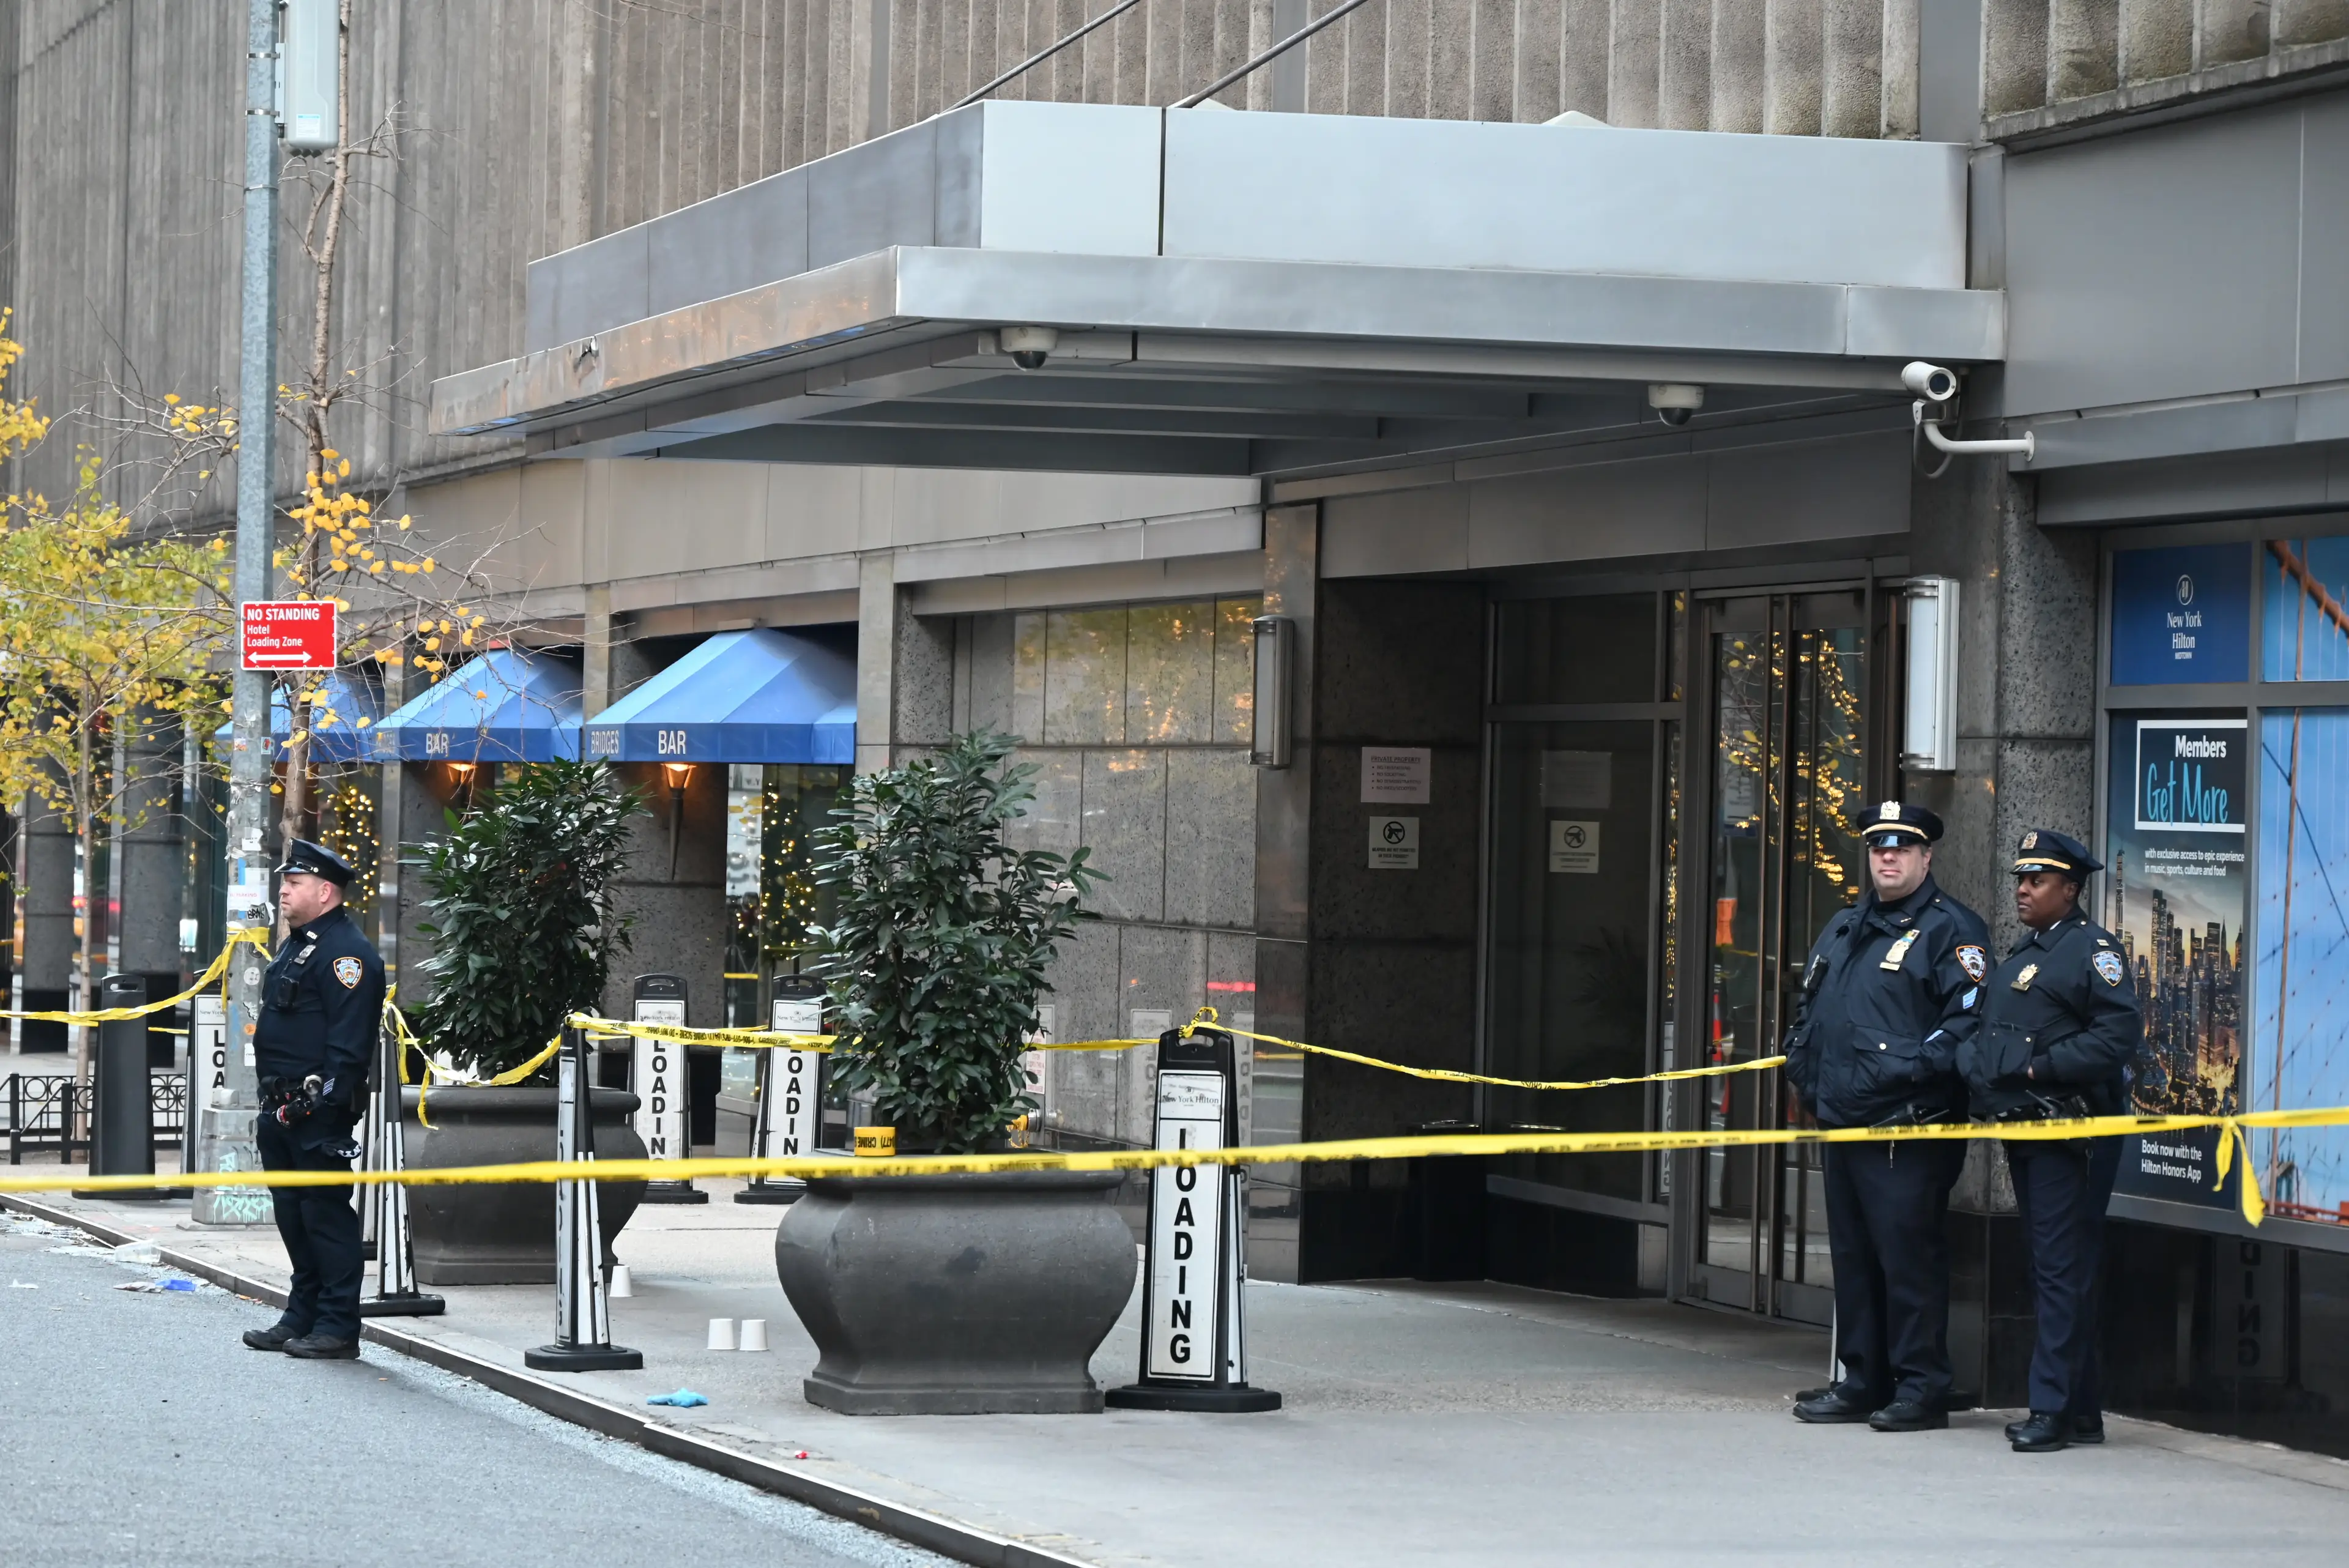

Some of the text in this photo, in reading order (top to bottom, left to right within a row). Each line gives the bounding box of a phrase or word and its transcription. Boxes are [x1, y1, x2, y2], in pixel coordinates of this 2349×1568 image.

[247, 608, 319, 621] NO STANDING
[2167, 611, 2202, 628] New York
[247, 625, 270, 634] Hotel
[247, 637, 303, 648] Loading Zone
[2172, 633, 2195, 648] Hilton
[426, 734, 449, 754] BAR
[591, 730, 686, 754] BRIDGES BAR
[2175, 735, 2227, 757] Members
[2147, 760, 2228, 827] Get More
[2145, 848, 2245, 864] with exclusive access to epic experience
[2145, 863, 2227, 877] in music, sports, culture and food
[680, 1030, 692, 1040] SCENE
[651, 1040, 667, 1160] LOADIN
[783, 1049, 803, 1155] OADIN
[858, 1137, 877, 1148] CRIME
[2142, 1139, 2202, 1161] Book now with the
[2141, 1159, 2202, 1184] Hilton Honors App
